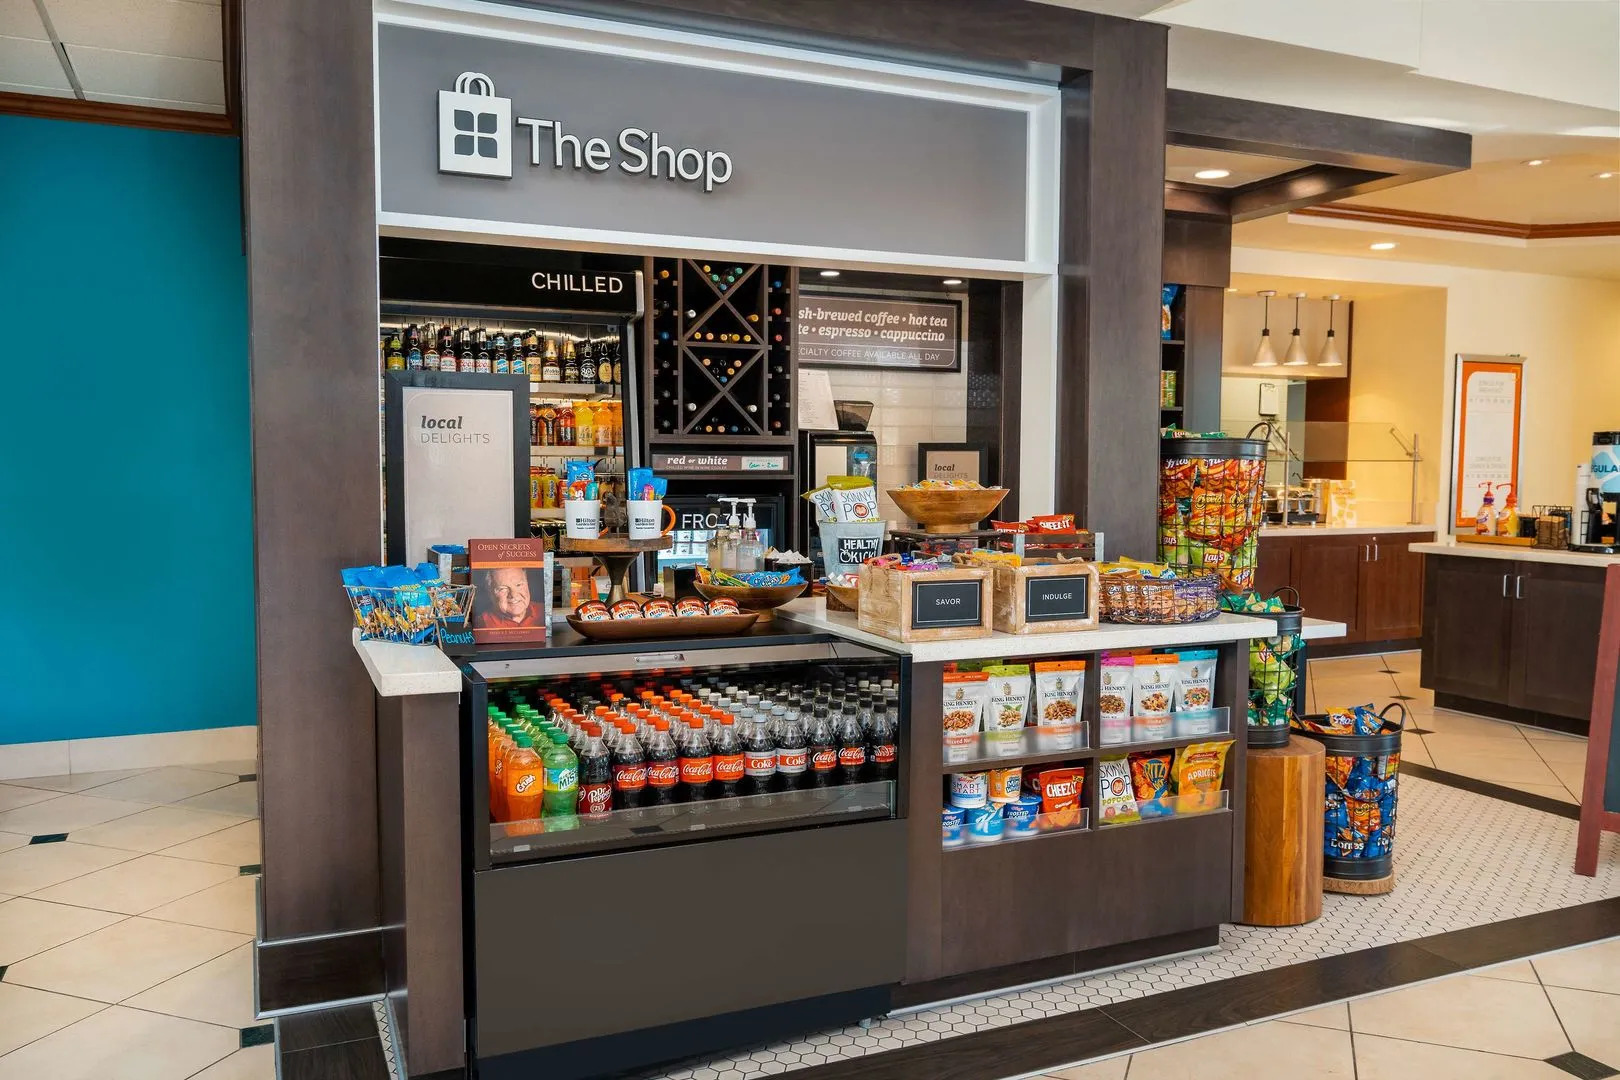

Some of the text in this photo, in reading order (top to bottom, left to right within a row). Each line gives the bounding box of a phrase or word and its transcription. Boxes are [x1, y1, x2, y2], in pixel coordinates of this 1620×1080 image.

[516, 116, 733, 192] The Shop
[531, 272, 623, 294] CHILLED
[798, 307, 947, 327] sh-brewed coffee hot tea
[818, 325, 871, 339] espresso
[880, 329, 945, 342] cappuccino
[798, 346, 940, 361] CIALTY COFFEE AVAILABLE ALL DAY
[421, 415, 463, 429] local
[421, 433, 490, 444] DELIGHTS
[667, 456, 686, 465] red
[698, 456, 728, 465] white
[934, 463, 955, 472] local
[841, 490, 873, 502] SKINNY
[843, 501, 877, 520] POP
[477, 543, 531, 551] OPEN SECRETS
[843, 538, 879, 550] HEALTHY
[498, 551, 505, 559] of
[1204, 552, 1225, 563] Lay's
[440, 628, 476, 644] Peanuts
[751, 758, 773, 769] Coke
[786, 755, 806, 766] Coke
[1144, 762, 1167, 780] RITZ
[1187, 768, 1217, 781] APRICOTS
[1101, 774, 1131, 799] POP
[1330, 838, 1365, 851] Doritos
